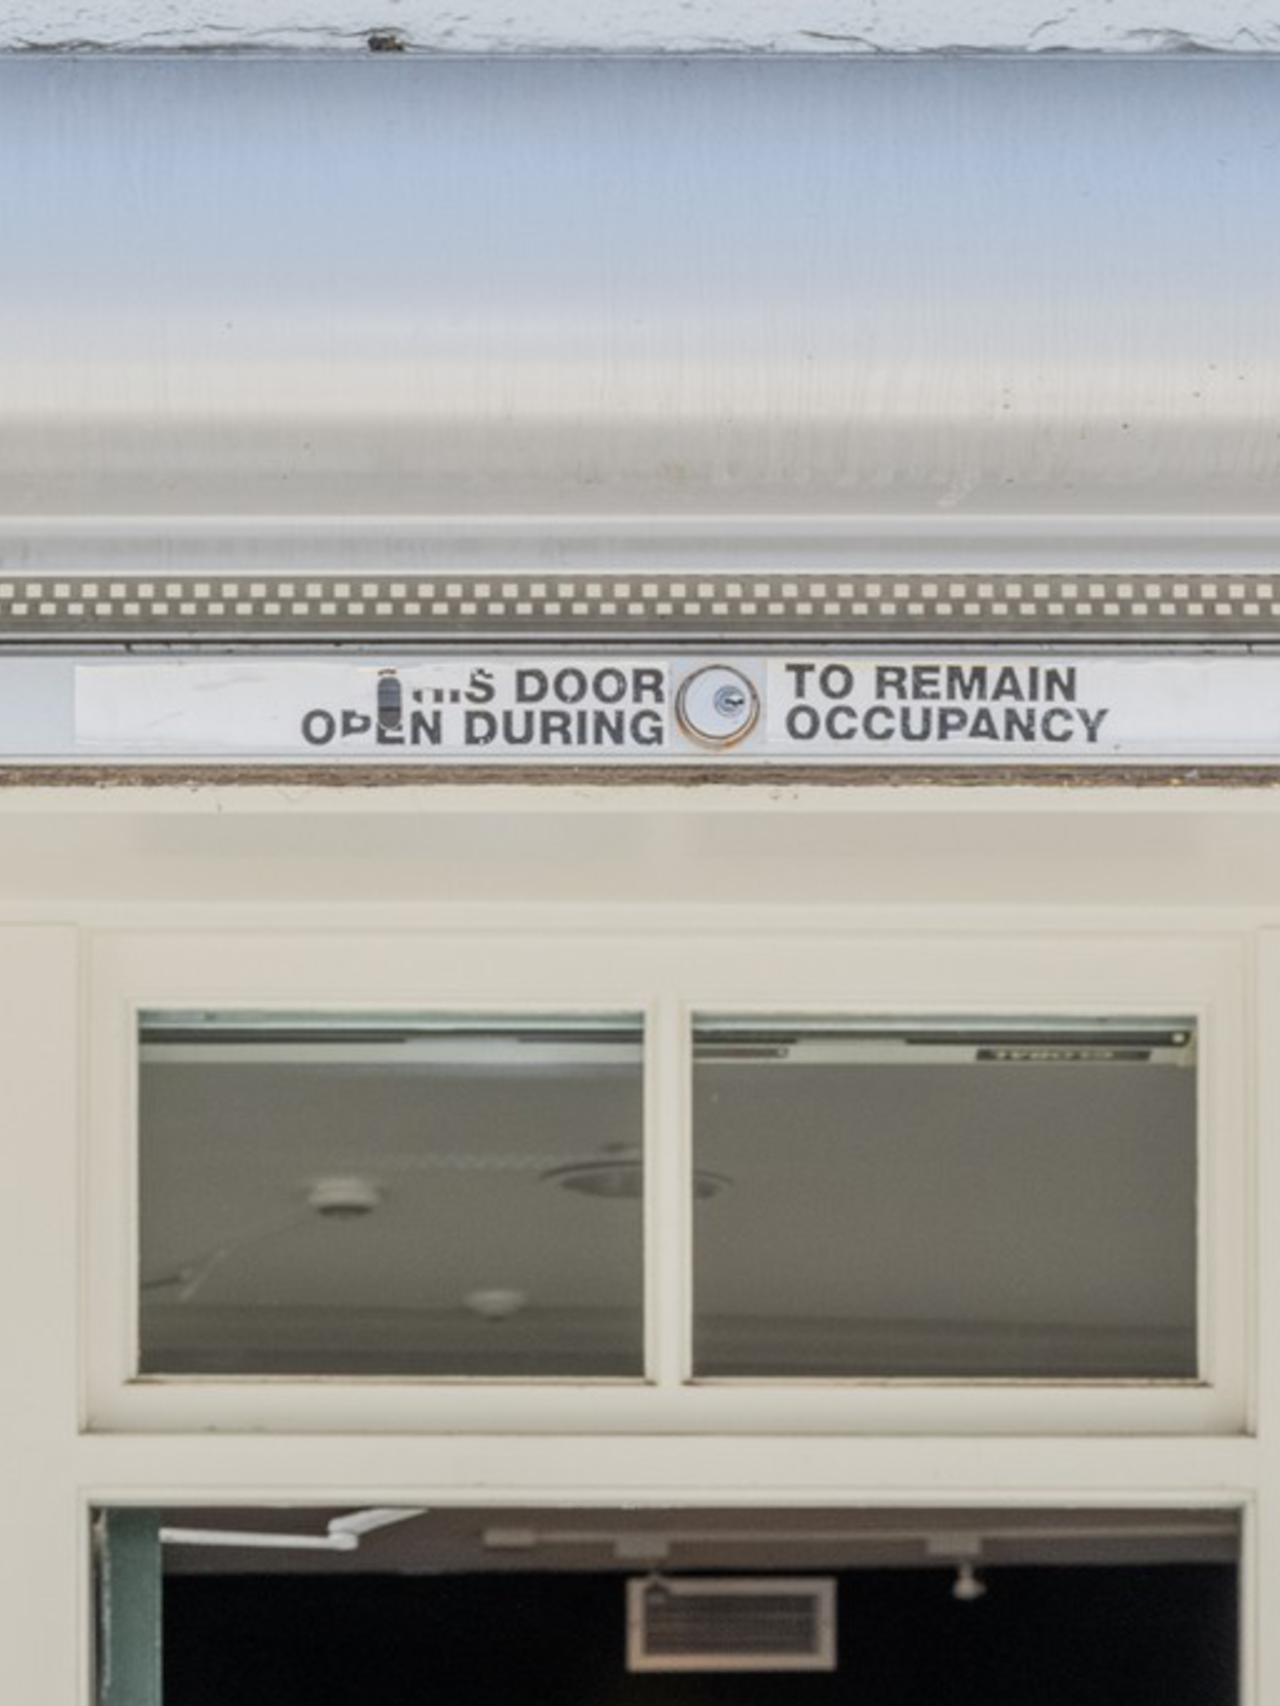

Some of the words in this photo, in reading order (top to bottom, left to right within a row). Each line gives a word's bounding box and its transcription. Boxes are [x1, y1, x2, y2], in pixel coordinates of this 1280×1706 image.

[515, 668, 665, 704] DOOR
[785, 663, 855, 699] TO
[875, 665, 1077, 701] REMAIN
[301, 708, 443, 746] OPEN
[464, 709, 664, 746] DURING
[785, 704, 1109, 743] OCCUPANCY
